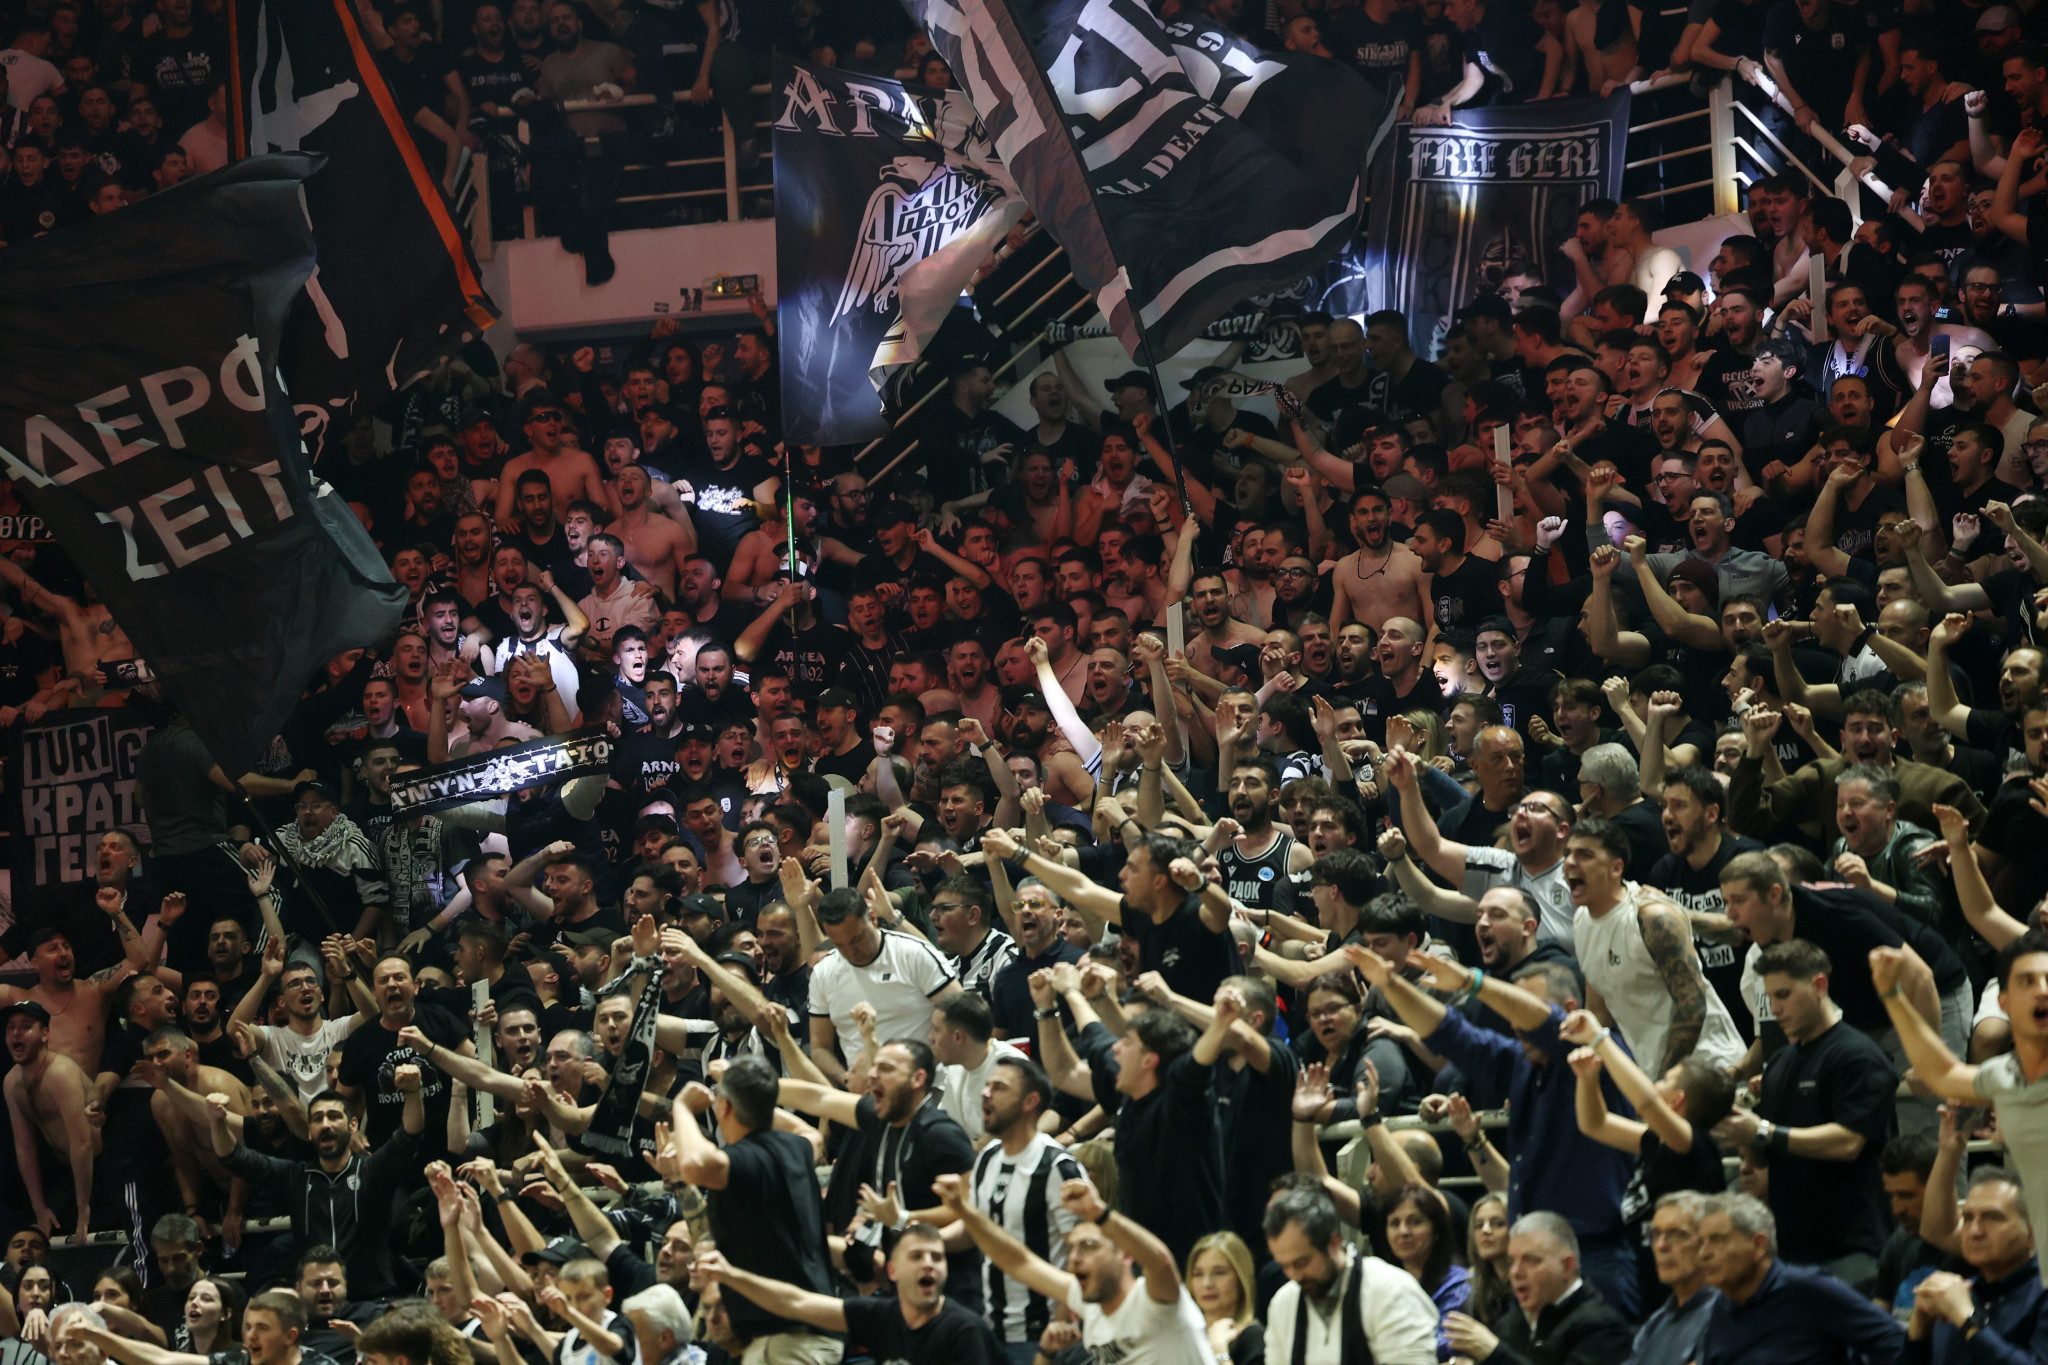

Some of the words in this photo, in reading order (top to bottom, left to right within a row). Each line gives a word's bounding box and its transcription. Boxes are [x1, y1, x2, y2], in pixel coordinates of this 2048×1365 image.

[1142, 102, 1225, 181] DEAT
[1407, 137, 1501, 179] FREE
[1506, 137, 1601, 178] GERI
[901, 189, 978, 233] ΠΑΟΚ
[0, 333, 267, 489] ΑΔΕΡΦ
[0, 516, 53, 540] ΘΥΡ
[95, 459, 295, 583] ΖΕΙΤ
[22, 719, 111, 781] TURI
[117, 727, 154, 779] G
[22, 779, 150, 836] ΚΡΑΤ
[34, 833, 144, 887] ΓΕ
[1228, 880, 1262, 900] PAOK
